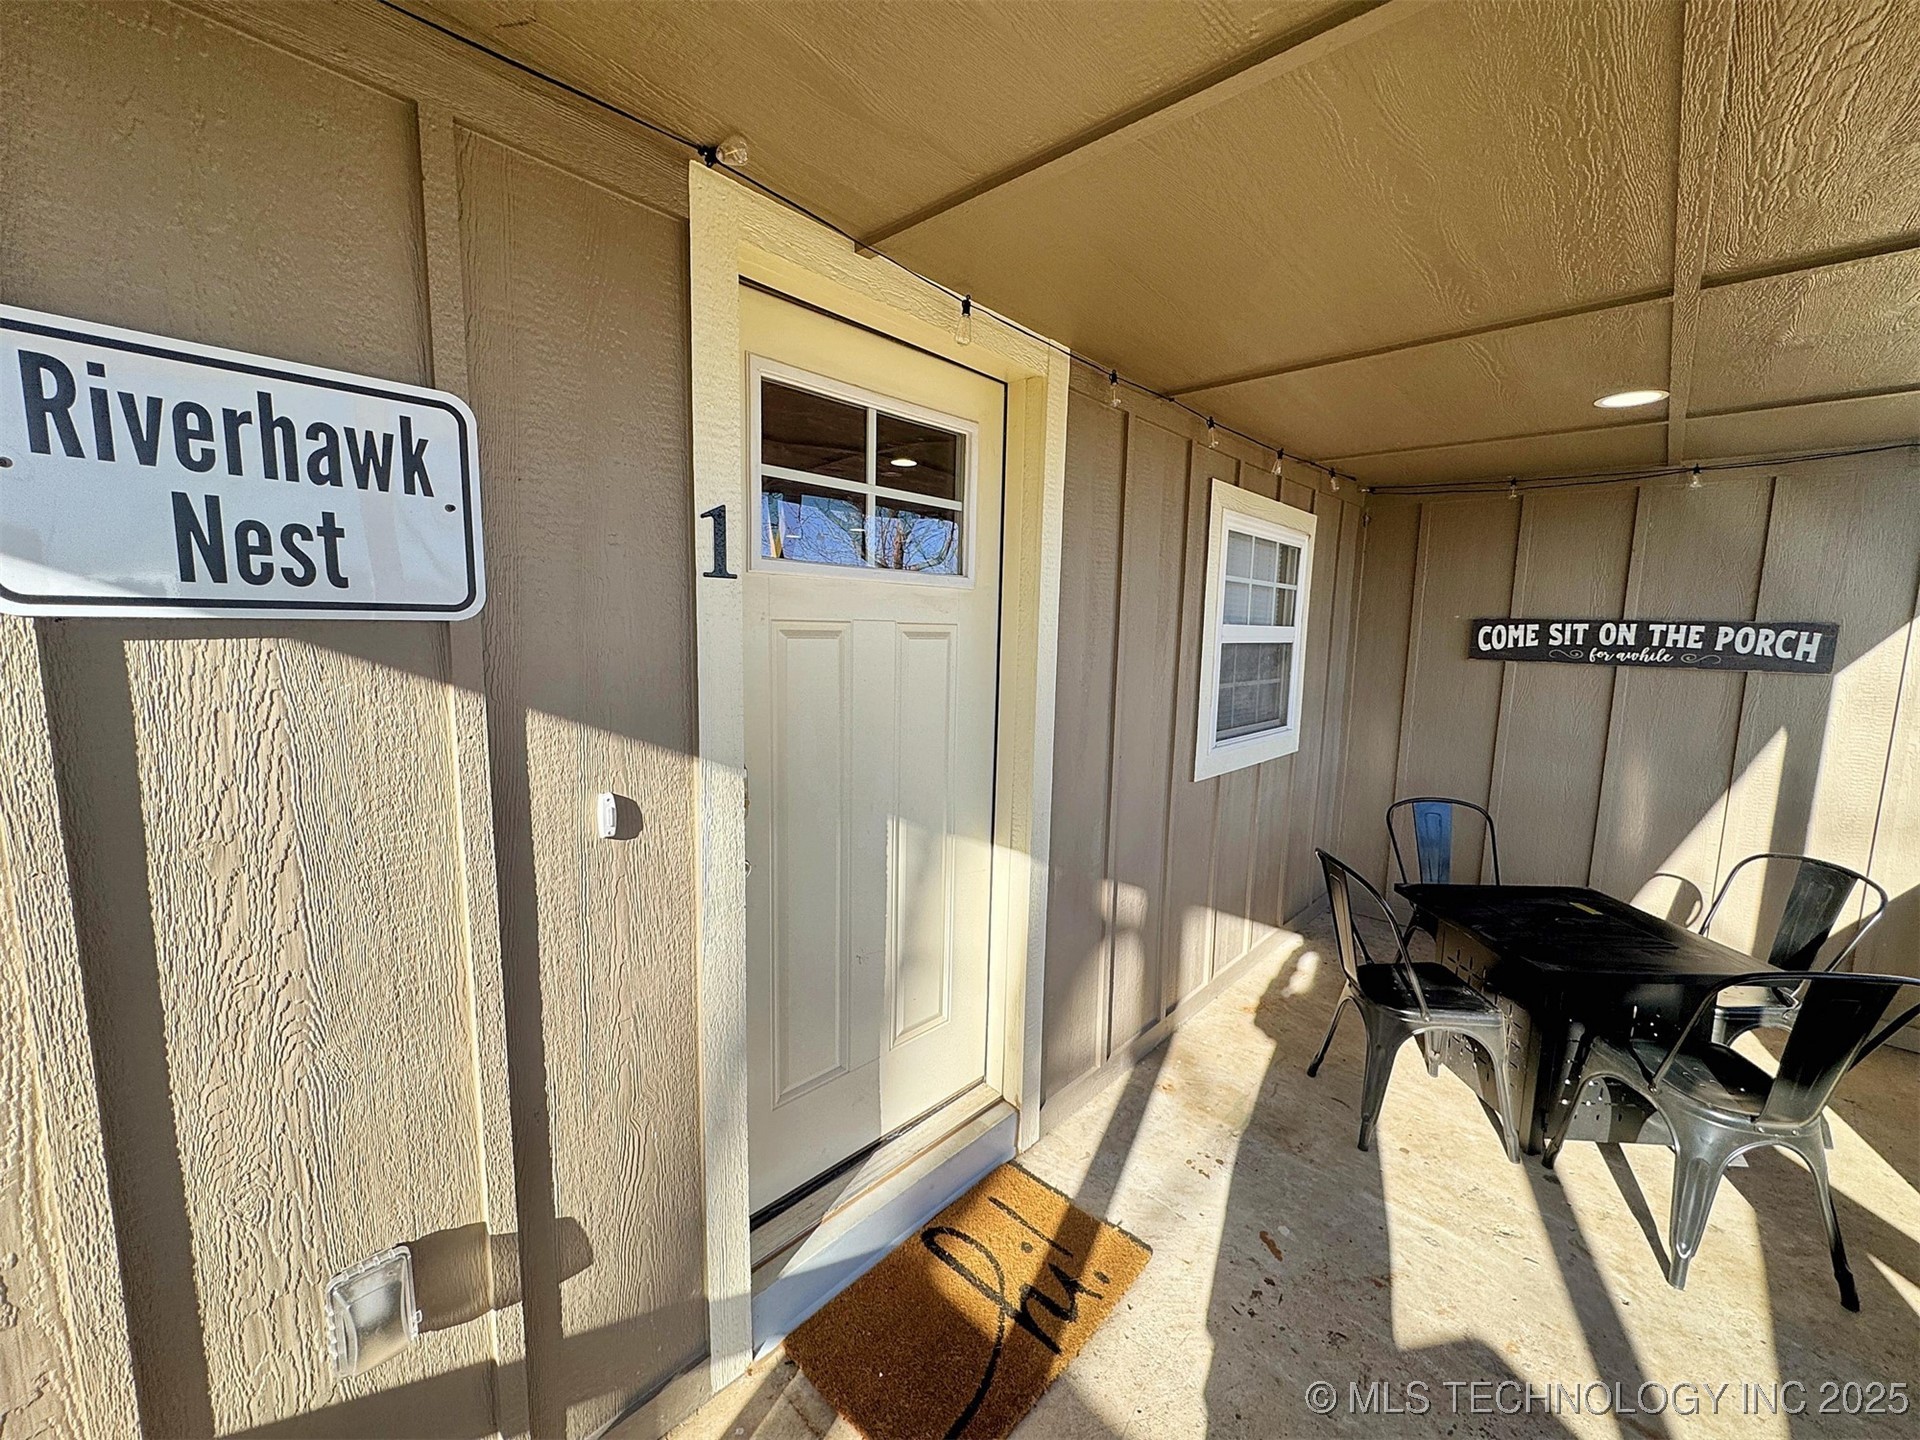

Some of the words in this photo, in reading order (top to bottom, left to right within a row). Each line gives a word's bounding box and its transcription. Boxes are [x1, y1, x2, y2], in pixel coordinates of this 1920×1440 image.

[18, 349, 434, 498] Riverhawk
[171, 491, 350, 589] Nest
[700, 504, 738, 579] 1
[1477, 624, 1540, 651] COME
[1548, 623, 1590, 647] SIT
[1599, 622, 1638, 647] ON
[1649, 624, 1706, 649] THE
[1714, 625, 1823, 664] PORCH
[1588, 646, 1614, 663] for
[1615, 646, 1674, 664] awhile
